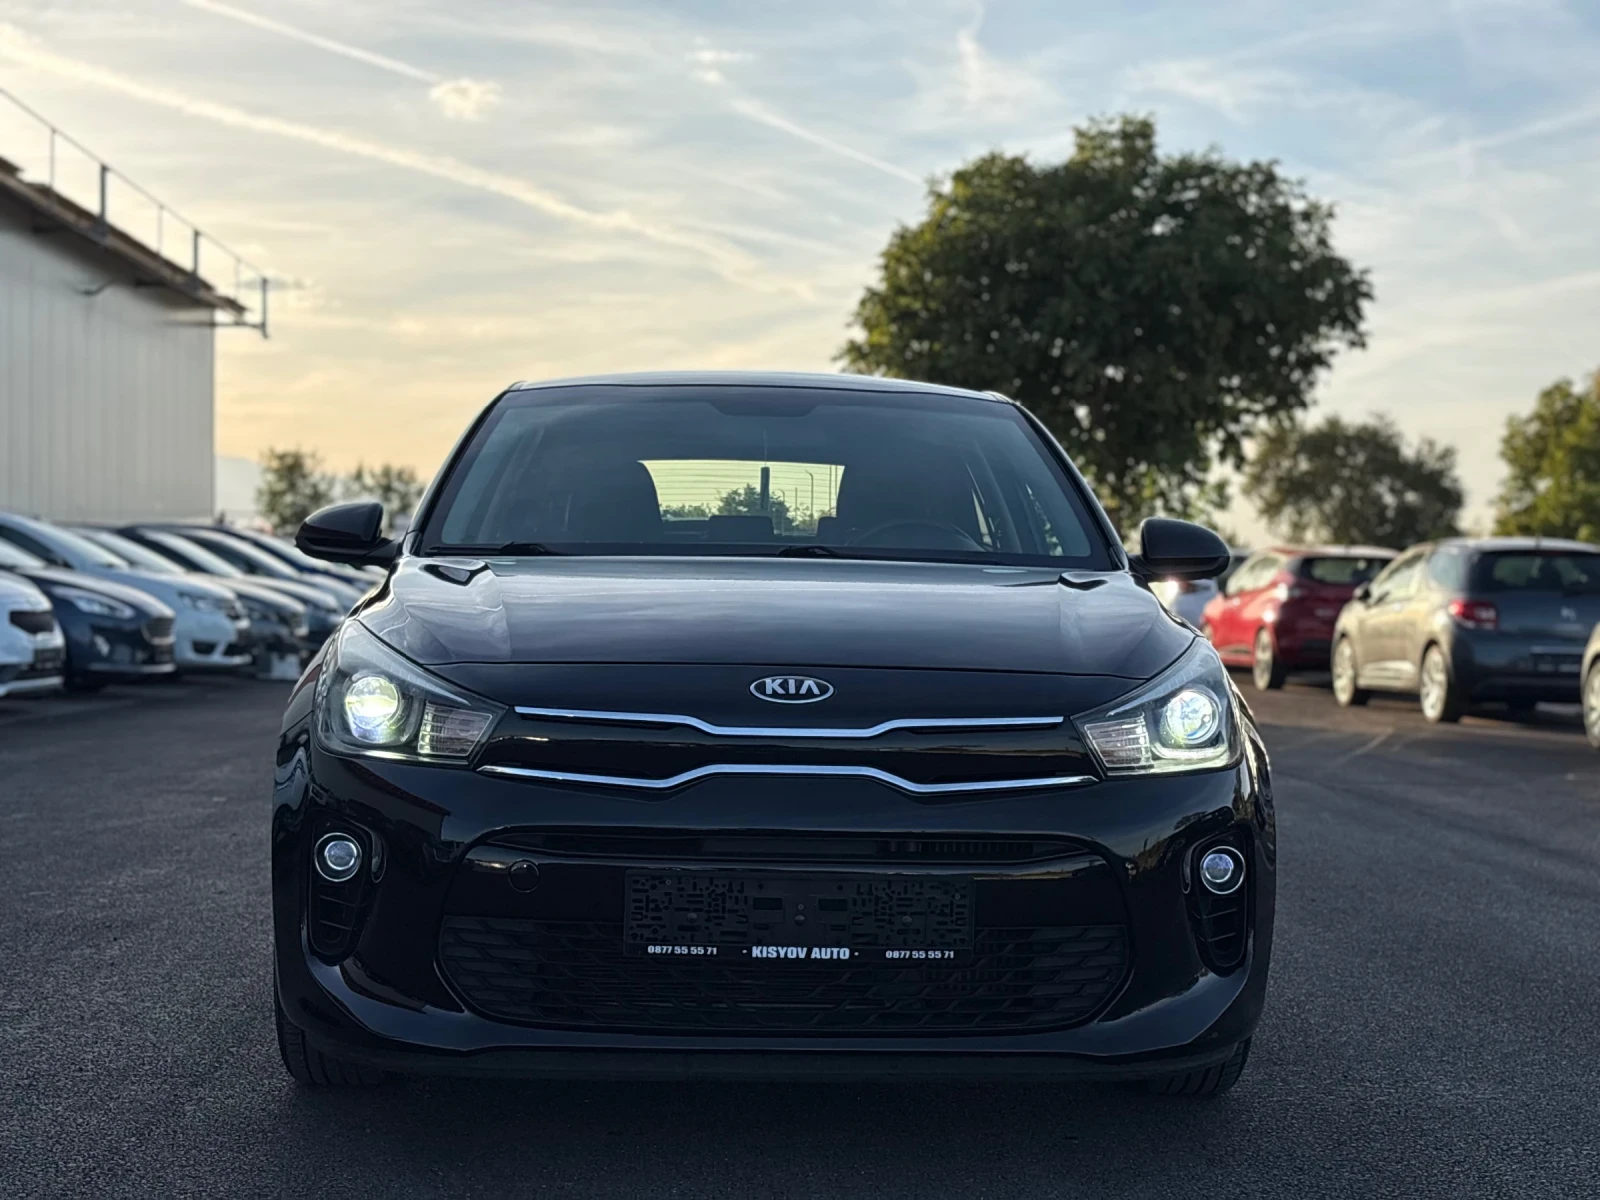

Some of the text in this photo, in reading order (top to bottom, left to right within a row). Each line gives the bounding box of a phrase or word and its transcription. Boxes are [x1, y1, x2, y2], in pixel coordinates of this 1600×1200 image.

[765, 679, 821, 695] KIA
[647, 945, 717, 955] 0877 55 55 71
[751, 945, 850, 960] KISYOV AUTO
[885, 950, 954, 959] 0877 55 55 71
